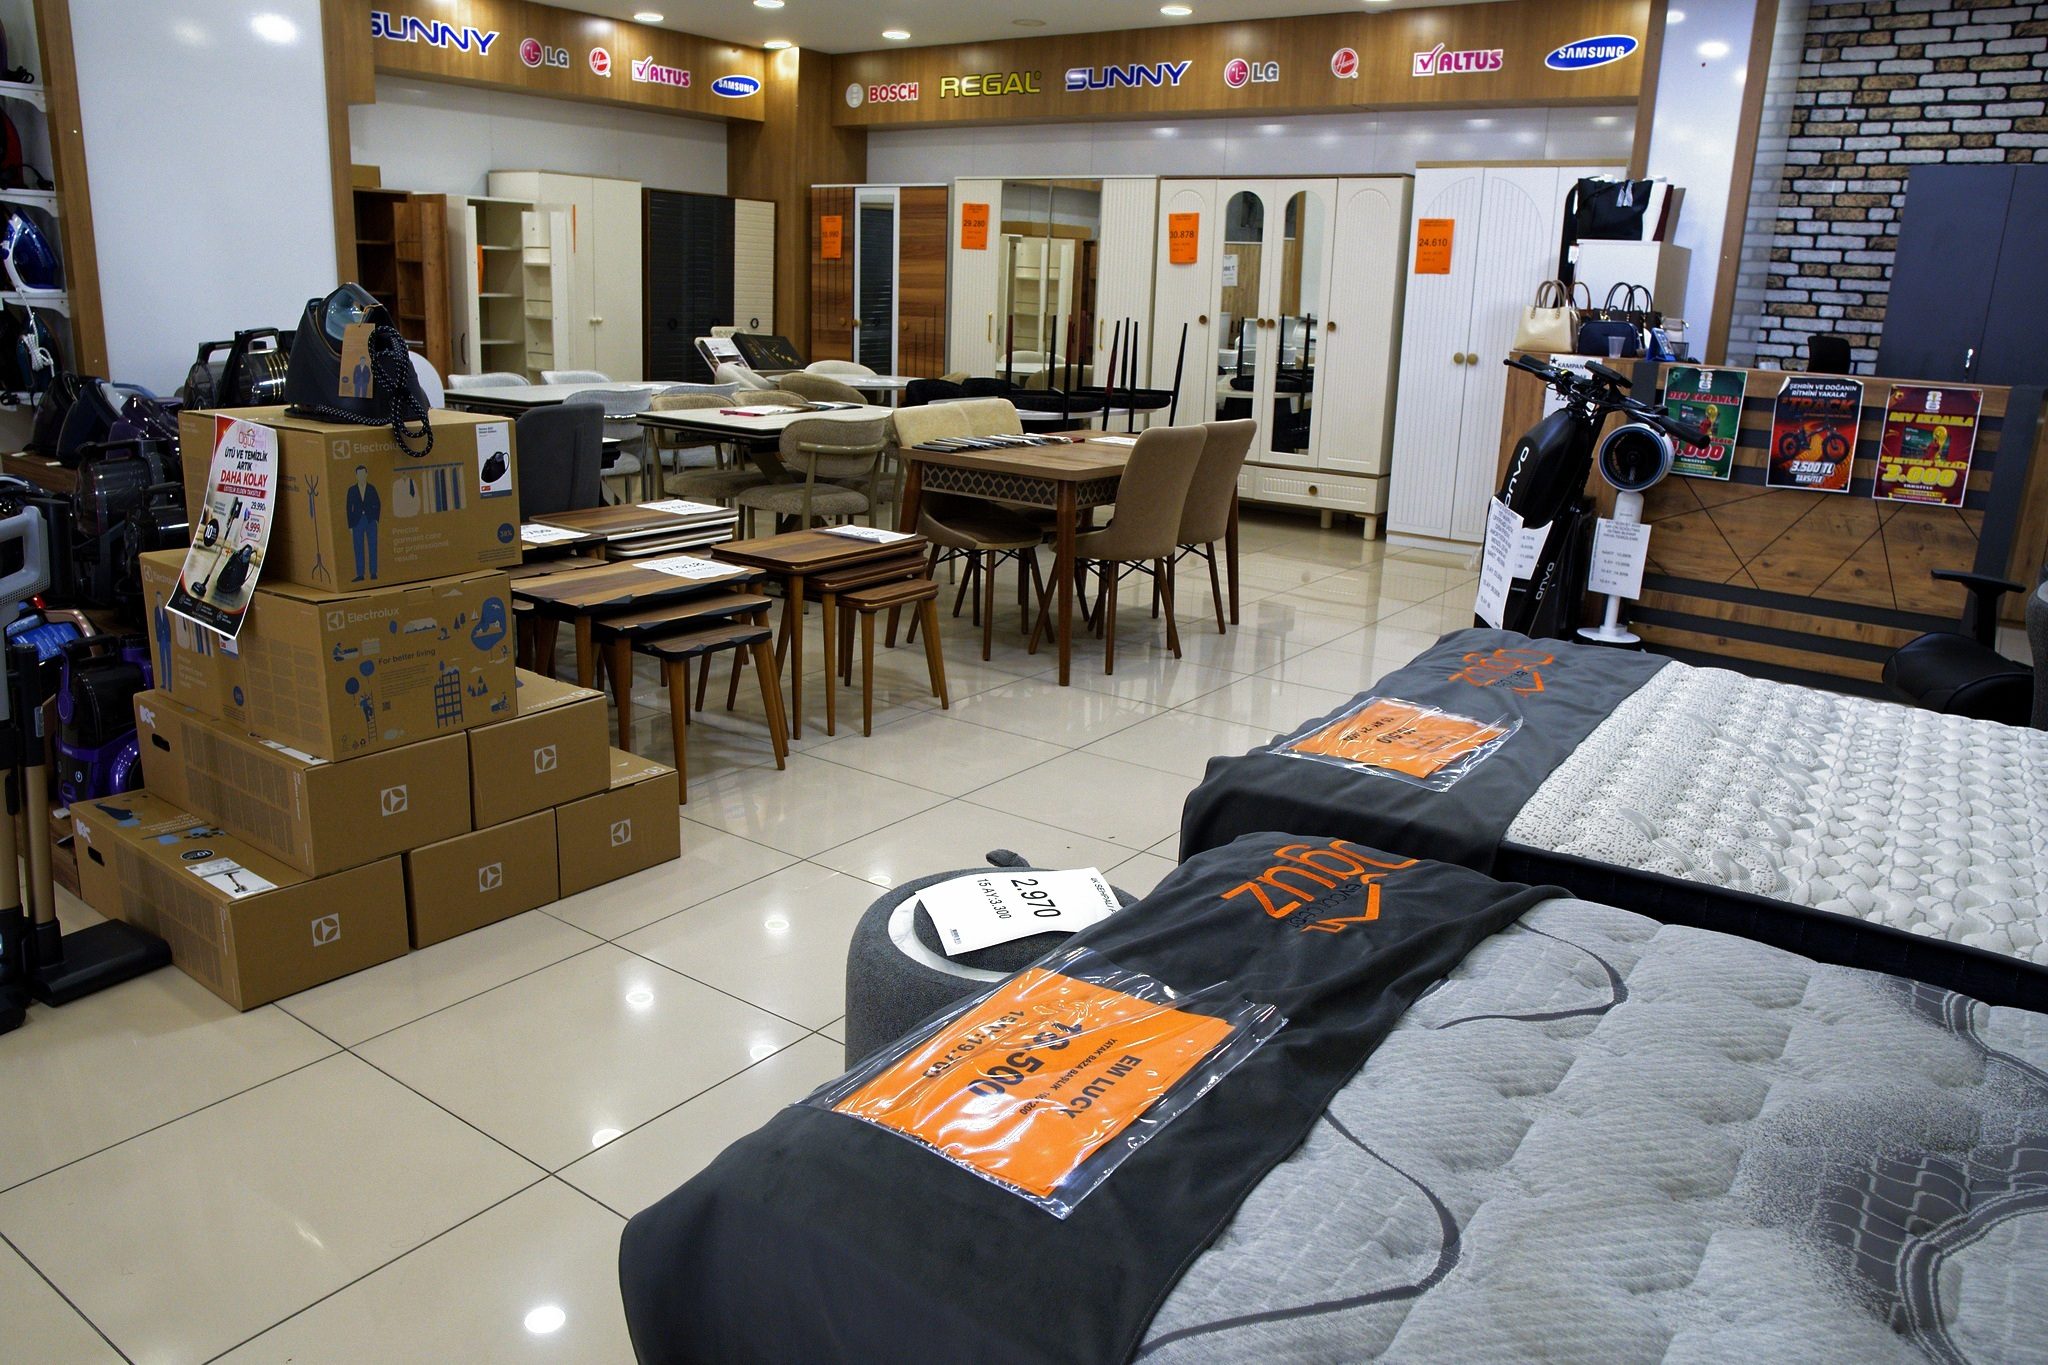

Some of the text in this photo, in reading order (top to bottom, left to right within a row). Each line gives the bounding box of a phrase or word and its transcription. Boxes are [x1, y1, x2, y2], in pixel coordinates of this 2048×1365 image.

[372, 11, 499, 55] SUNNY
[546, 47, 568, 67] LG
[1438, 49, 1503, 72] ALTUS
[1558, 44, 1625, 60] SAMSUNG
[649, 67, 690, 87] ALTUS
[1066, 60, 1192, 92] SUNNY
[1252, 61, 1278, 81] LG
[717, 79, 755, 93] SAMSUNG
[869, 82, 919, 103] BOSCH
[940, 72, 1040, 98] REGAL
[1825, 382, 1857, 391] DOĞANIN
[224, 446, 268, 462] ÜTÜ VE TEMİZLİK
[236, 461, 253, 471] ARTIK
[1790, 461, 1835, 475] 3.500 TL
[220, 470, 242, 484] DAHA
[243, 471, 268, 487] KOLAY
[1504, 446, 1529, 508] onvo
[347, 607, 400, 624] Electrolux
[392, 653, 415, 663] better
[1010, 878, 1061, 918] 2.970
[1096, 1038, 1118, 1056] YATAK
[1078, 1053, 1098, 1070] BAZA
[1050, 1067, 1078, 1092] BAŞLIK
[1062, 1054, 1144, 1120] EM LUCY
